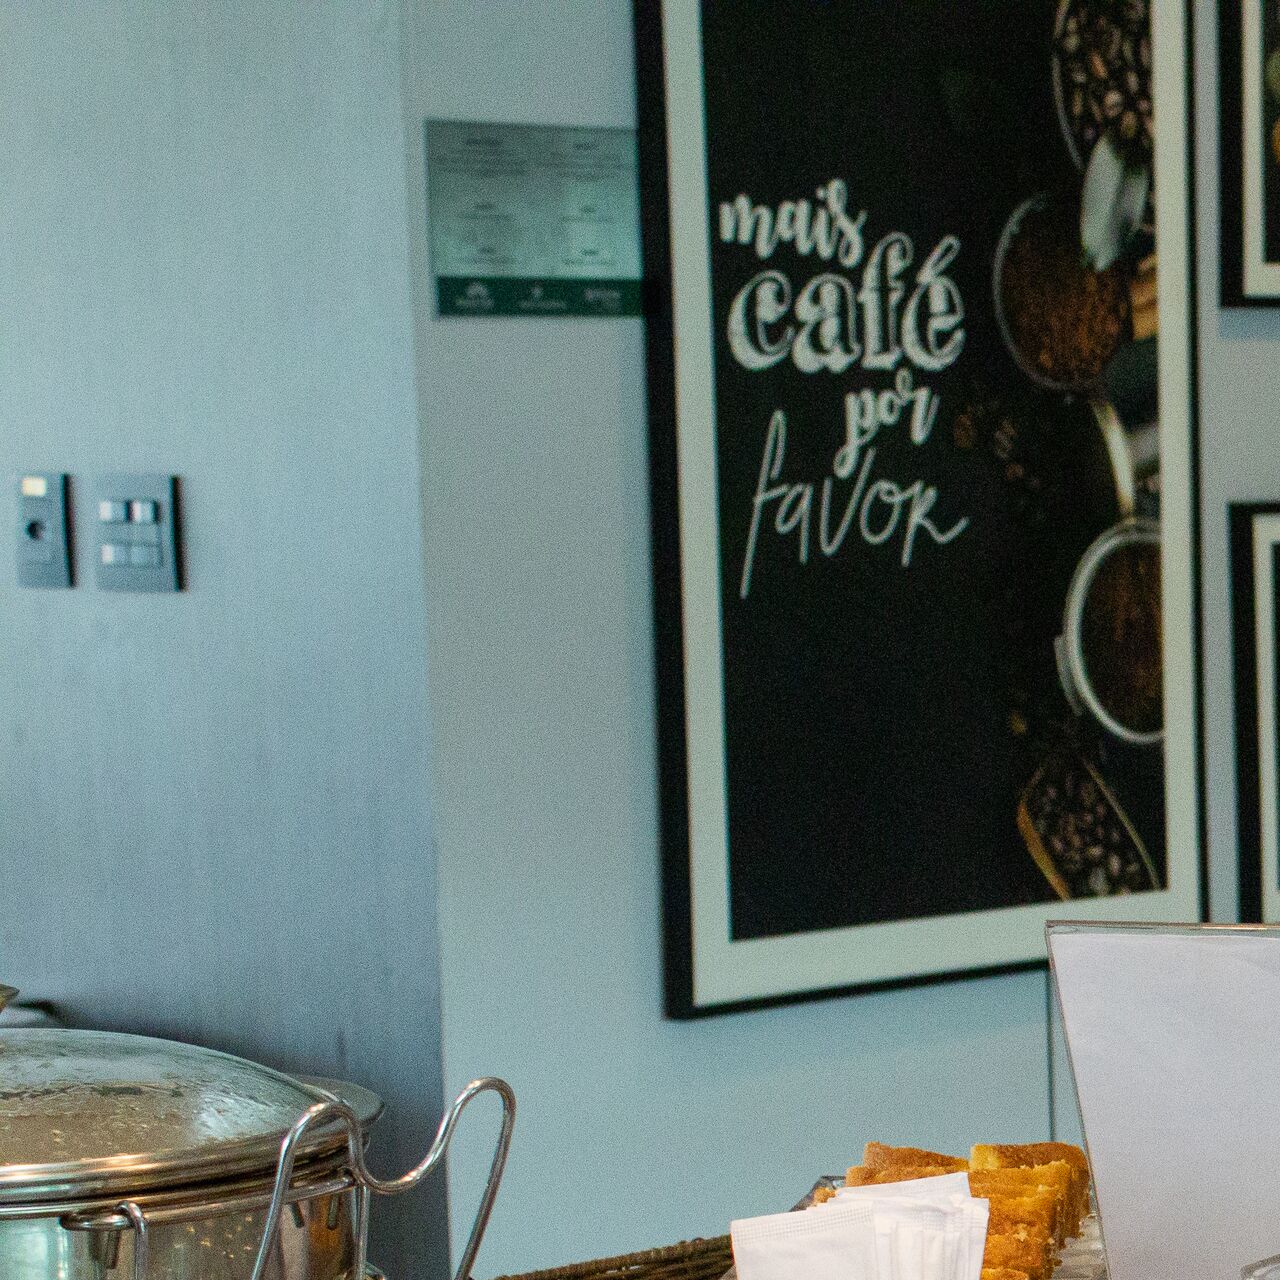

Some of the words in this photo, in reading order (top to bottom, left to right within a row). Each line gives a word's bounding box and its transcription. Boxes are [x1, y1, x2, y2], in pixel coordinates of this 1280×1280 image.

[720, 178, 867, 267] mais
[728, 232, 966, 371] café
[834, 367, 938, 476] por
